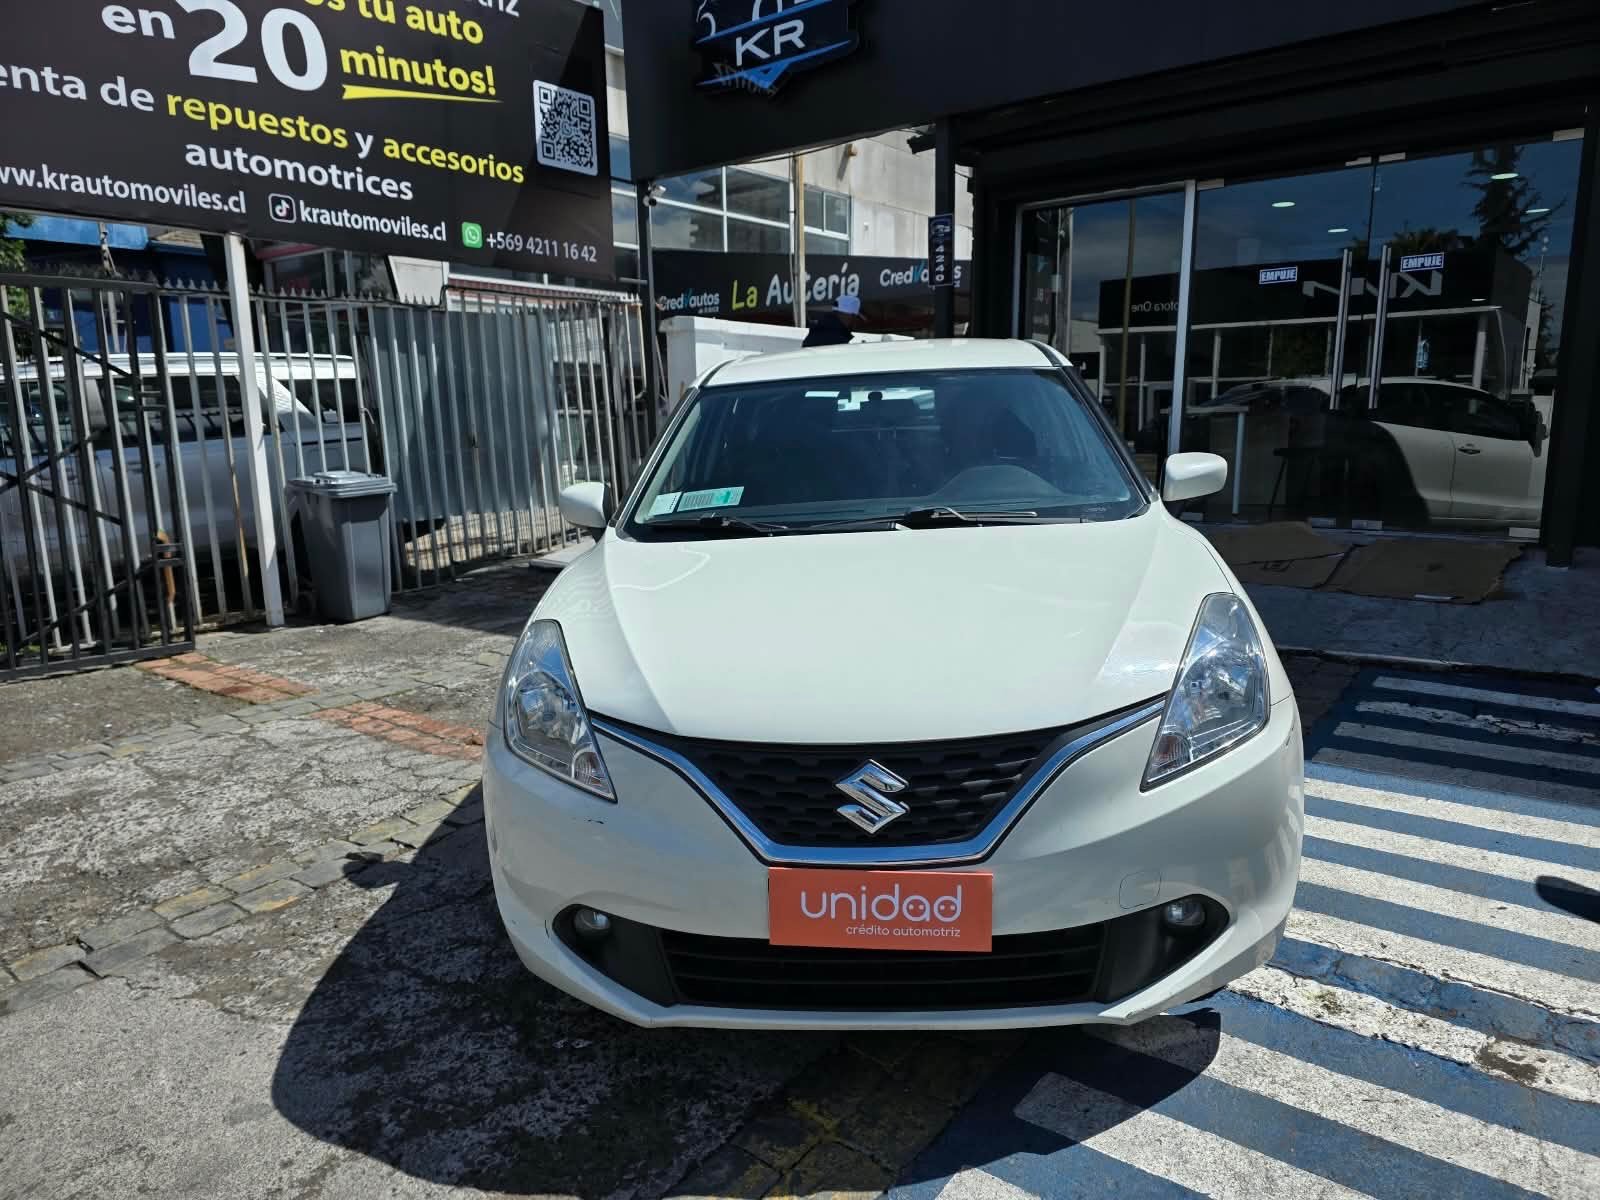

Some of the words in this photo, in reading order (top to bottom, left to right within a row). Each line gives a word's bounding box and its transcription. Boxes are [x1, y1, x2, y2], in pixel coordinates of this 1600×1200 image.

[405, 4, 484, 44] auto
[735, 19, 806, 66] KR
[101, 3, 177, 39] en
[174, 0, 328, 91] 20
[339, 44, 497, 95] minutos!
[0, 62, 87, 101] nta
[100, 75, 155, 112] de
[166, 92, 349, 150] repuestos
[353, 131, 375, 159] y
[382, 137, 525, 184] accesorios
[184, 143, 414, 201] automotrices
[299, 200, 448, 242] krautomoviles.cl
[486, 231, 524, 252] +569
[525, 236, 559, 257] 4211
[1402, 255, 1442, 269] EMPUJE
[732, 280, 758, 310] La
[765, 261, 861, 307] Autería
[1260, 269, 1297, 282] EMPUJE
[799, 882, 963, 923] unidad
[846, 924, 890, 936] crédito
[893, 926, 961, 938] automotriz
